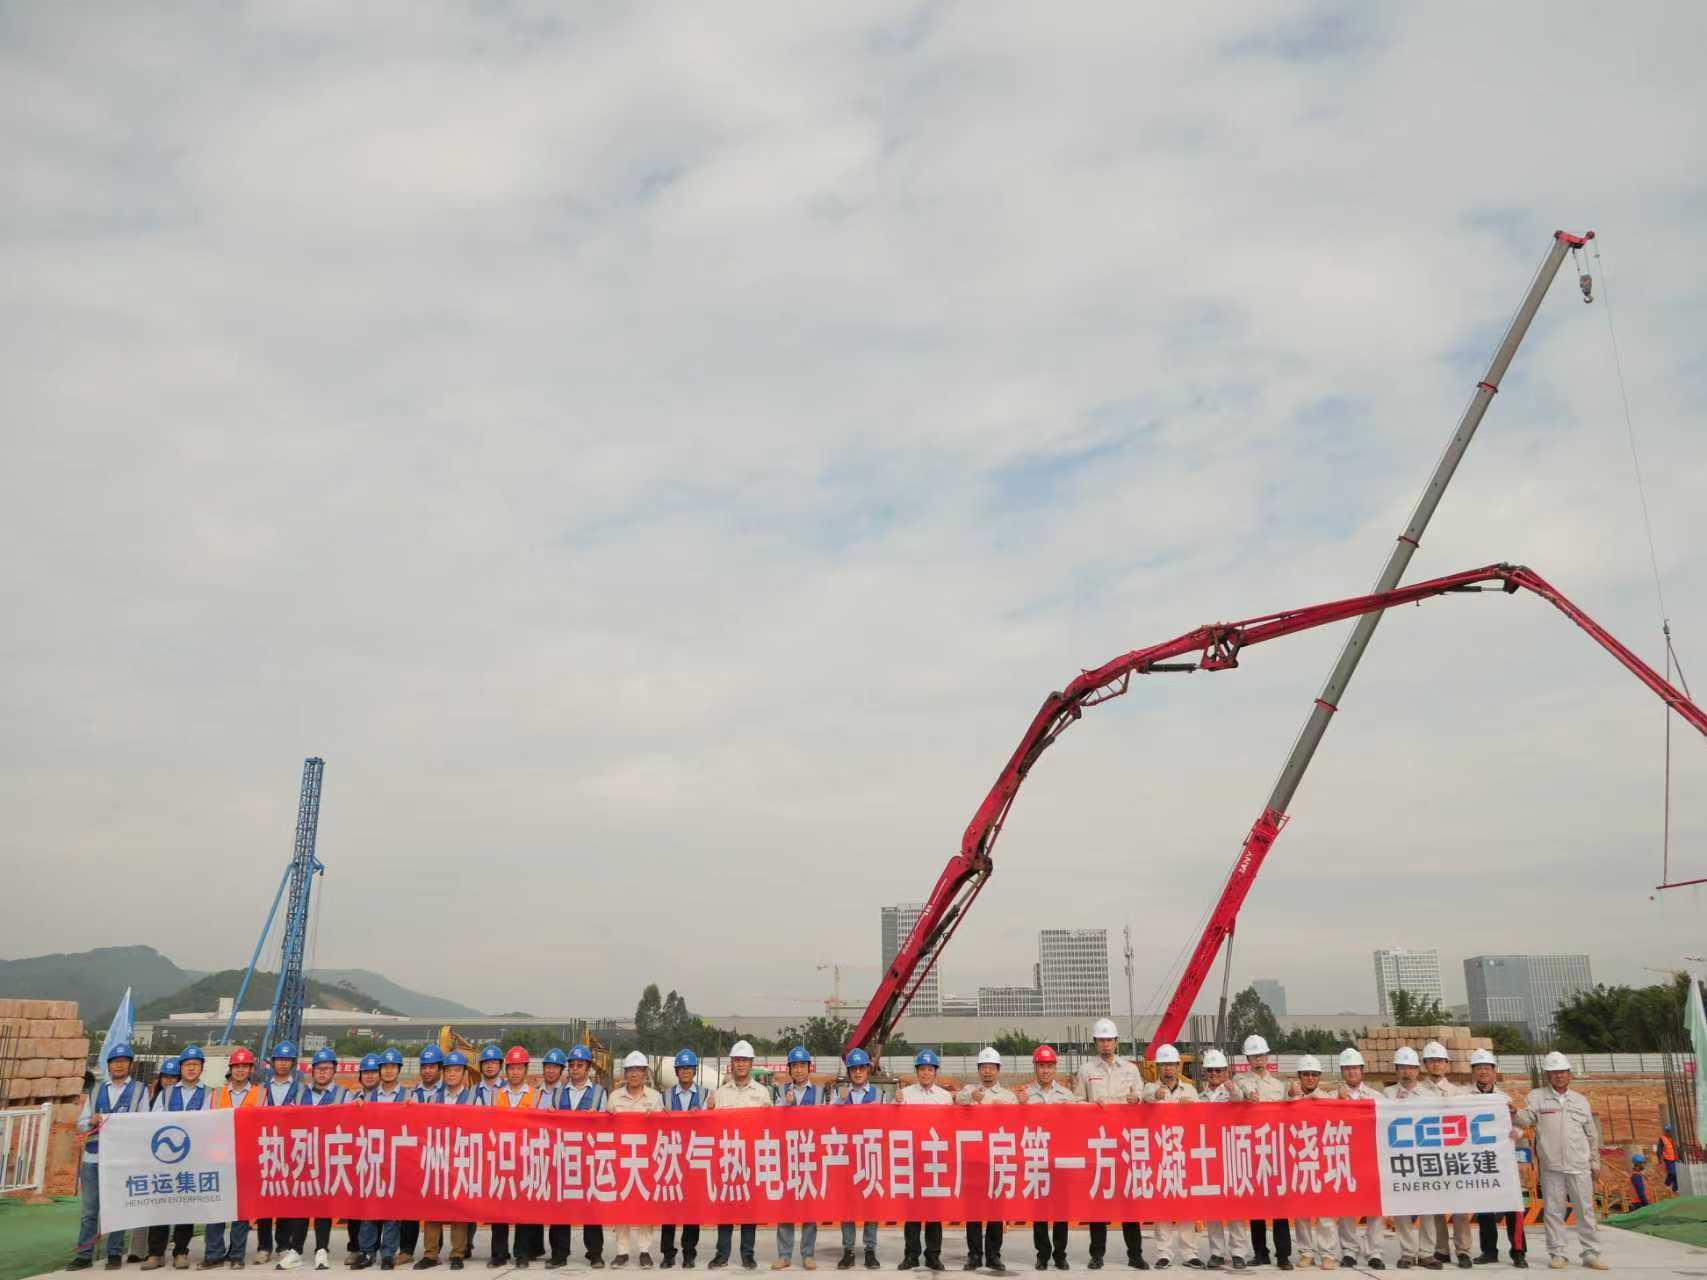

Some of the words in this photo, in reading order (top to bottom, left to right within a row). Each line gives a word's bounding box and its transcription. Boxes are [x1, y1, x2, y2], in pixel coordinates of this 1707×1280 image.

[257, 1120, 1357, 1202] 热烈庆祝广州知识城恒运天然气热电联产项目主厂房第一方混凝土顺利浇筑
[1390, 1150, 1500, 1178] 中国能建
[125, 1171, 220, 1197] 恒运集团
[1393, 1180, 1451, 1192] ENERGY
